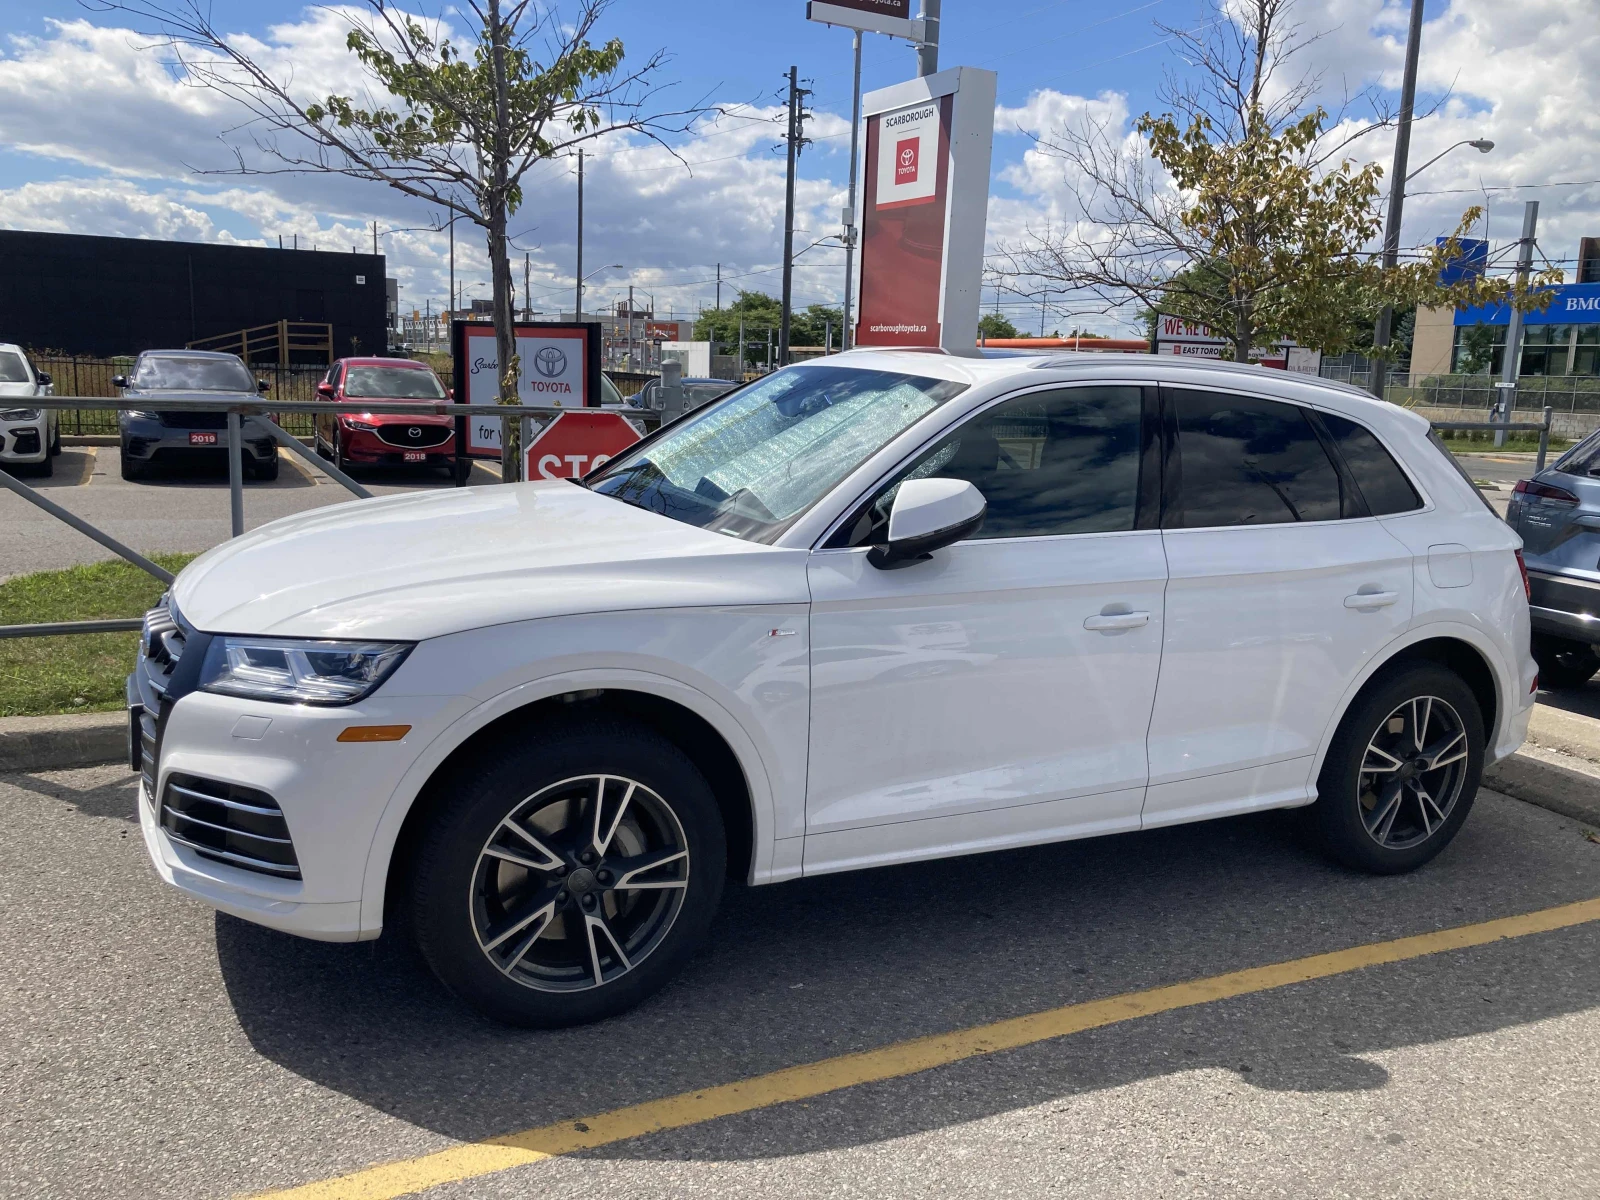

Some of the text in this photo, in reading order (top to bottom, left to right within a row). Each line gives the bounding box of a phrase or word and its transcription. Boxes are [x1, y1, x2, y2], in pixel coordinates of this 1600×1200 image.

[886, 107, 934, 128] SCARBOROUGH
[898, 165, 916, 175] TOYOTA
[870, 323, 927, 334] scarboroughtoyota.ca
[1182, 346, 1222, 356] EAST TORO
[470, 357, 499, 375] Scarbo
[530, 381, 572, 394] TOYOTA
[478, 424, 495, 440] for
[191, 435, 216, 443] 2019
